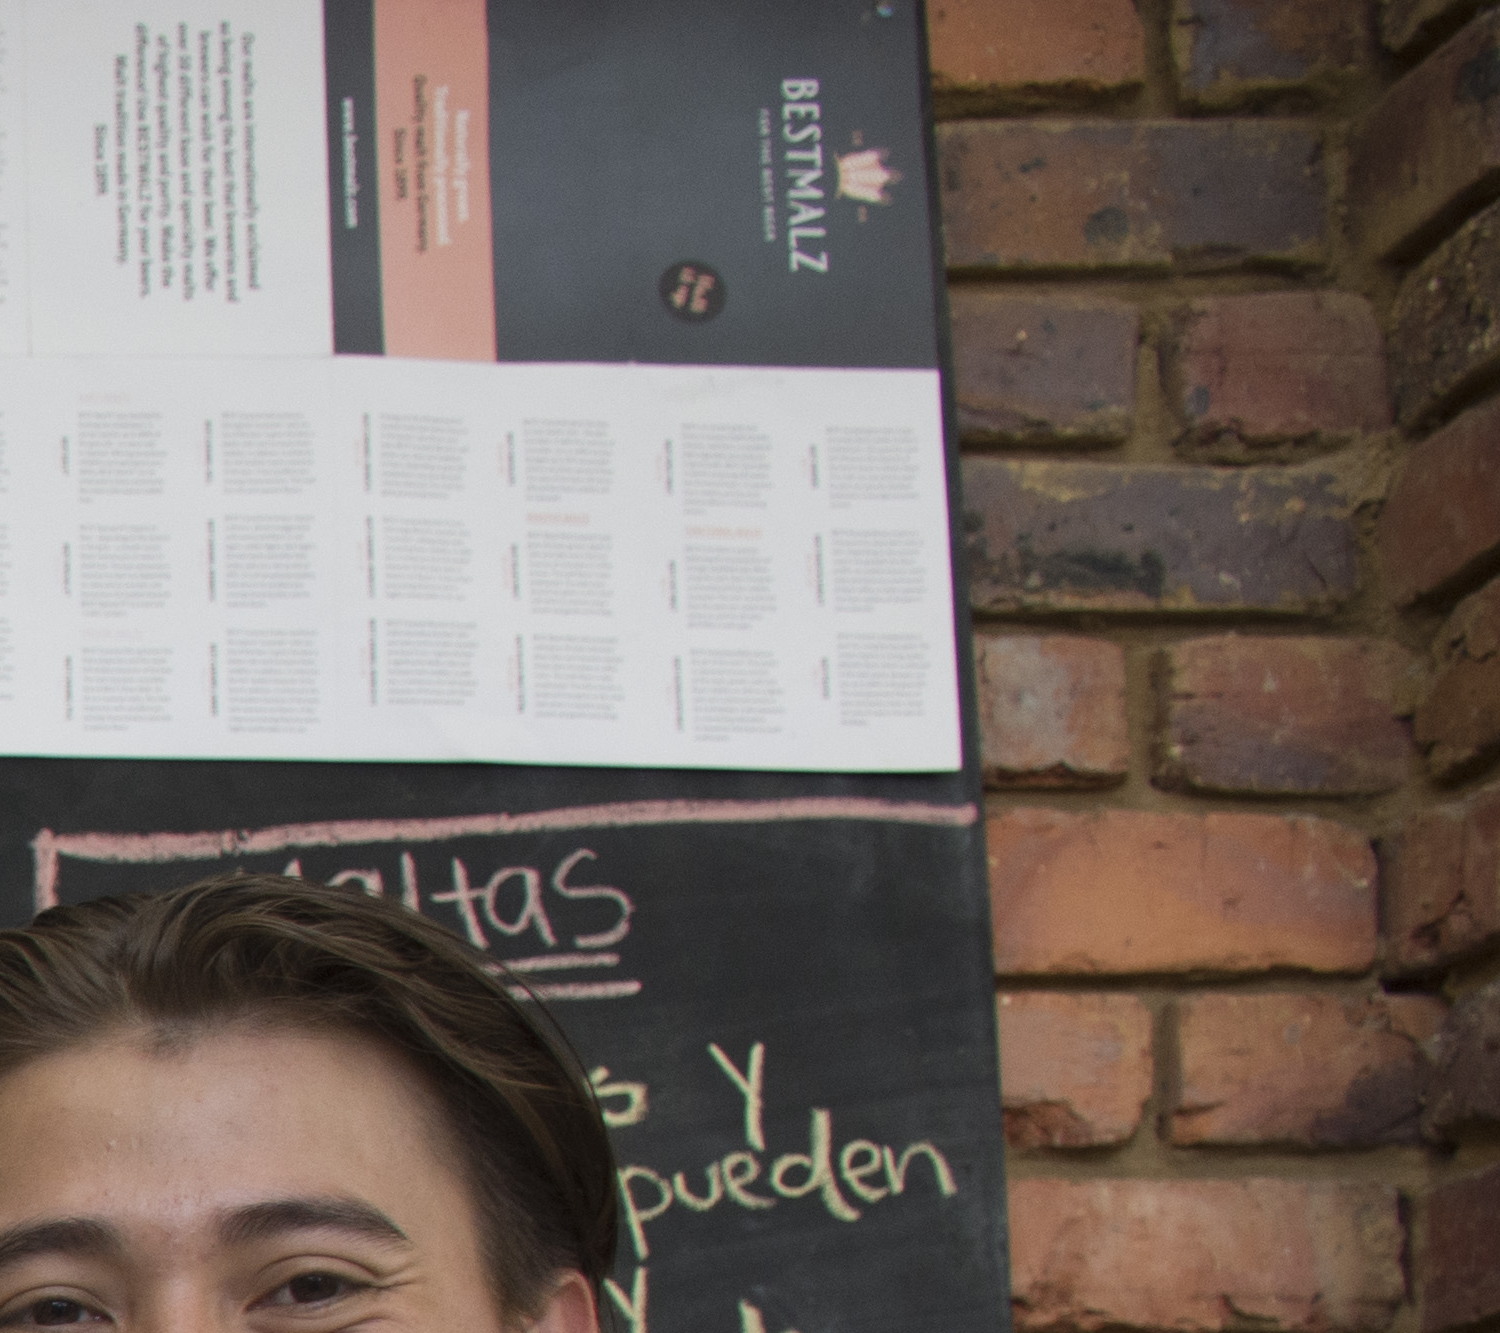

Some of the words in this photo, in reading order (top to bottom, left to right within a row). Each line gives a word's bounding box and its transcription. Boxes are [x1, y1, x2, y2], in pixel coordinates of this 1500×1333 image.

[781, 78, 830, 273] BESTMALZ
[285, 849, 636, 949] ltas
[617, 1107, 958, 1261] pueden
